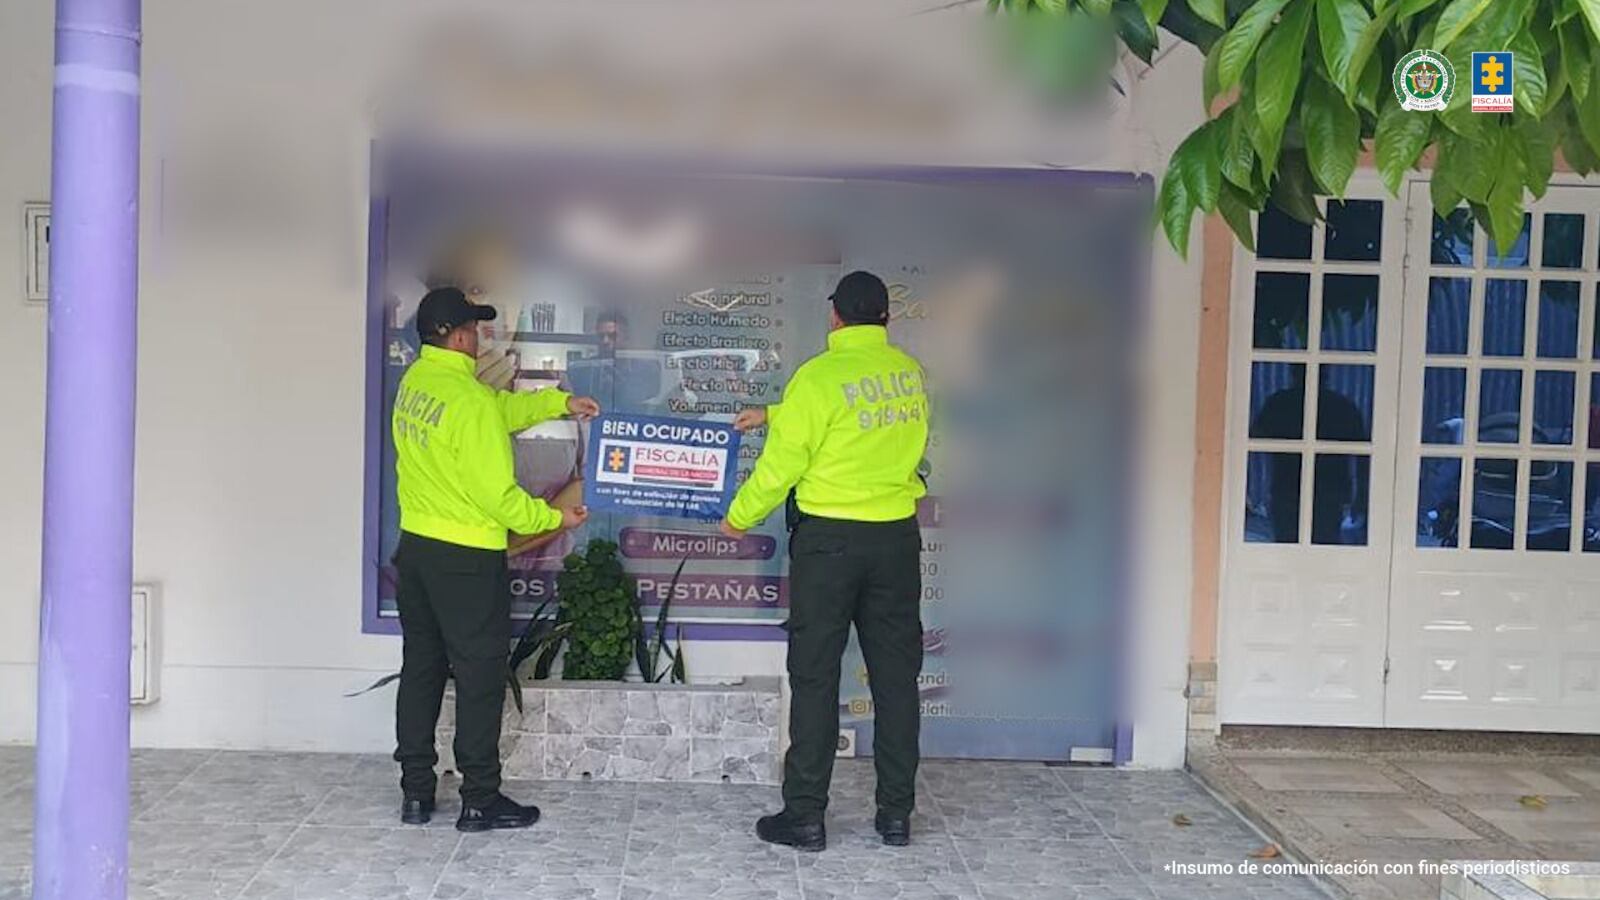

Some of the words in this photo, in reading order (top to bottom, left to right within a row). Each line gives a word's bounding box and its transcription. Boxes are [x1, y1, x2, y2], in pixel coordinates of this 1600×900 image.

[664, 335, 706, 347] Efecto
[602, 420, 638, 436] BIEN
[643, 423, 729, 444] OCUPADO
[635, 446, 719, 467] FISCALÍA
[652, 535, 738, 555] Microlips
[509, 579, 545, 596] OS
[636, 578, 779, 602] PESTAÑAS
